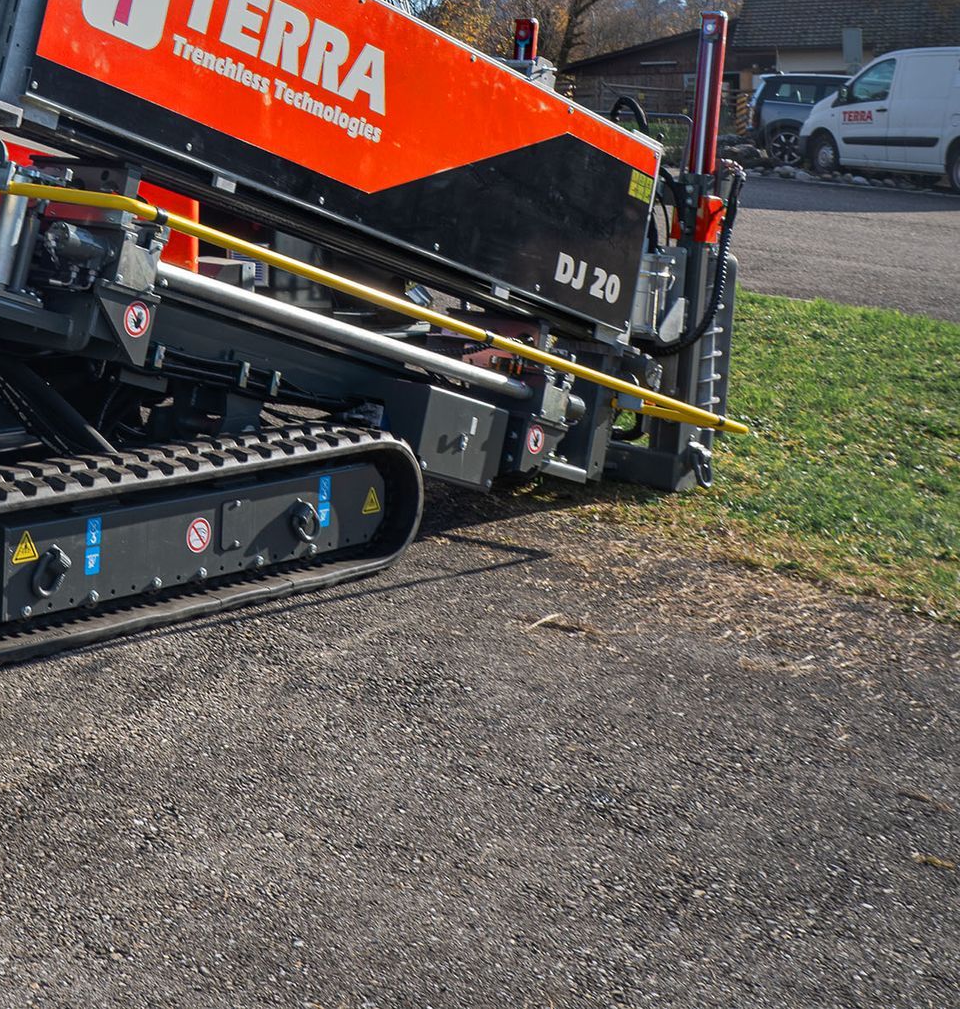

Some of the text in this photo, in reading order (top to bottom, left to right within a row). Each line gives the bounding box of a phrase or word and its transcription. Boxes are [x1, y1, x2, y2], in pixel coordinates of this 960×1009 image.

[172, 33, 382, 143] Trenchless Technologies
[842, 110, 873, 122] TERRA
[554, 251, 621, 304] DJ 20
